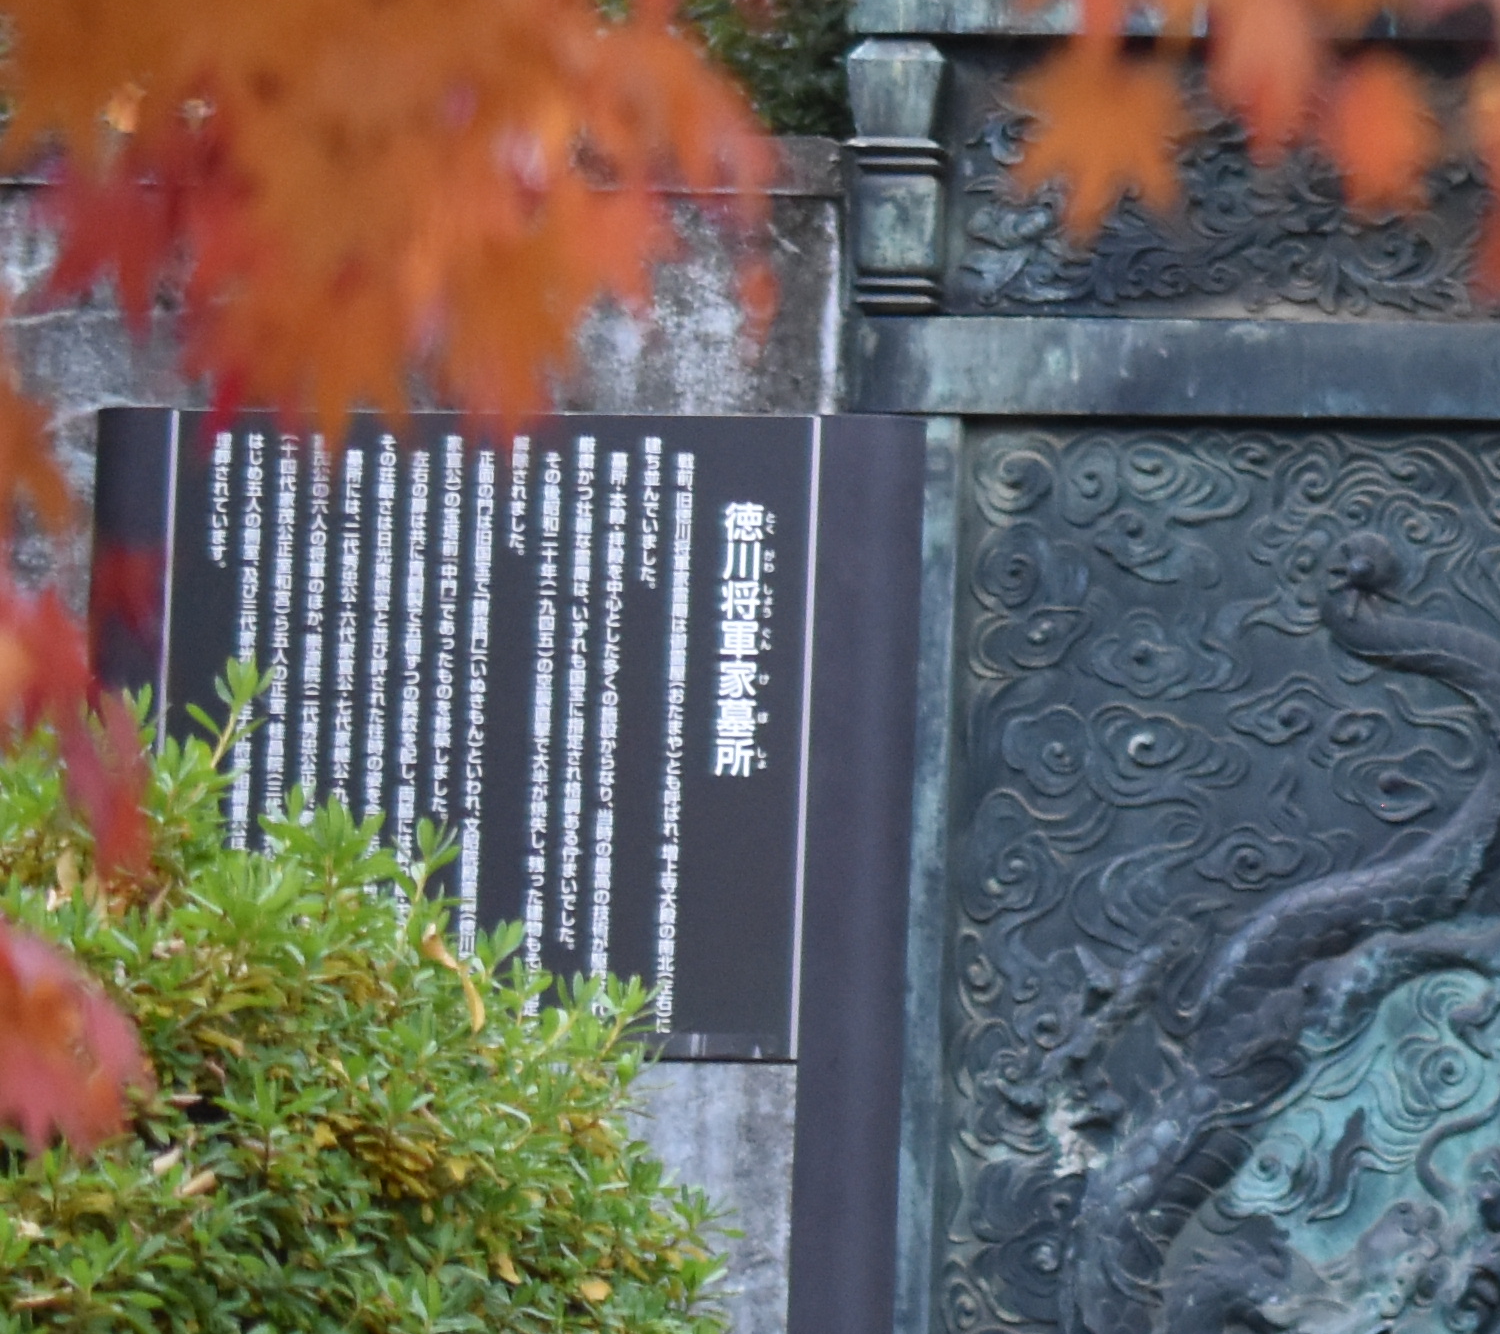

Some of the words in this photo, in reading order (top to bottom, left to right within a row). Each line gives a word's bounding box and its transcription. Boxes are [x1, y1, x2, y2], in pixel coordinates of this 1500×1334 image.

[640, 437, 662, 589] 建ち並んでいました。
[765, 511, 776, 535] とく
[763, 549, 776, 573] がわ
[762, 583, 773, 619] しょう
[714, 502, 764, 777] 徳川将軍家墓所
[761, 627, 772, 651] ぐん
[757, 746, 768, 769] しょ
